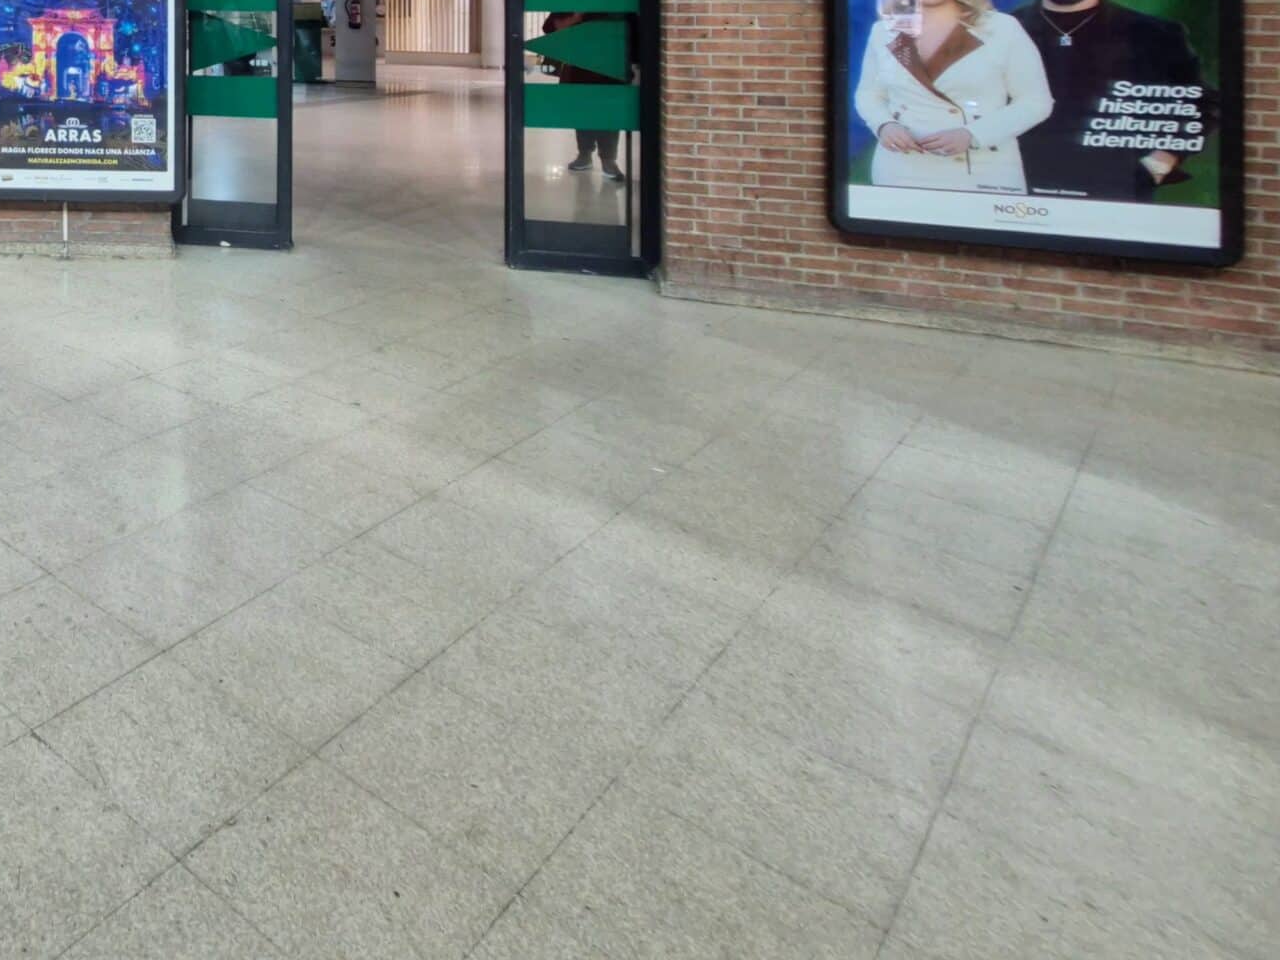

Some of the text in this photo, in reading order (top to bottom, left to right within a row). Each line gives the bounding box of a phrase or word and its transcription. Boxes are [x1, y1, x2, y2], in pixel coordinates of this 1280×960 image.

[1112, 80, 1203, 98] Somos
[1099, 98, 1202, 119] historia,
[1090, 117, 1203, 134] cultura e
[44, 129, 102, 143] ARRAS
[1082, 132, 1204, 152] identidad
